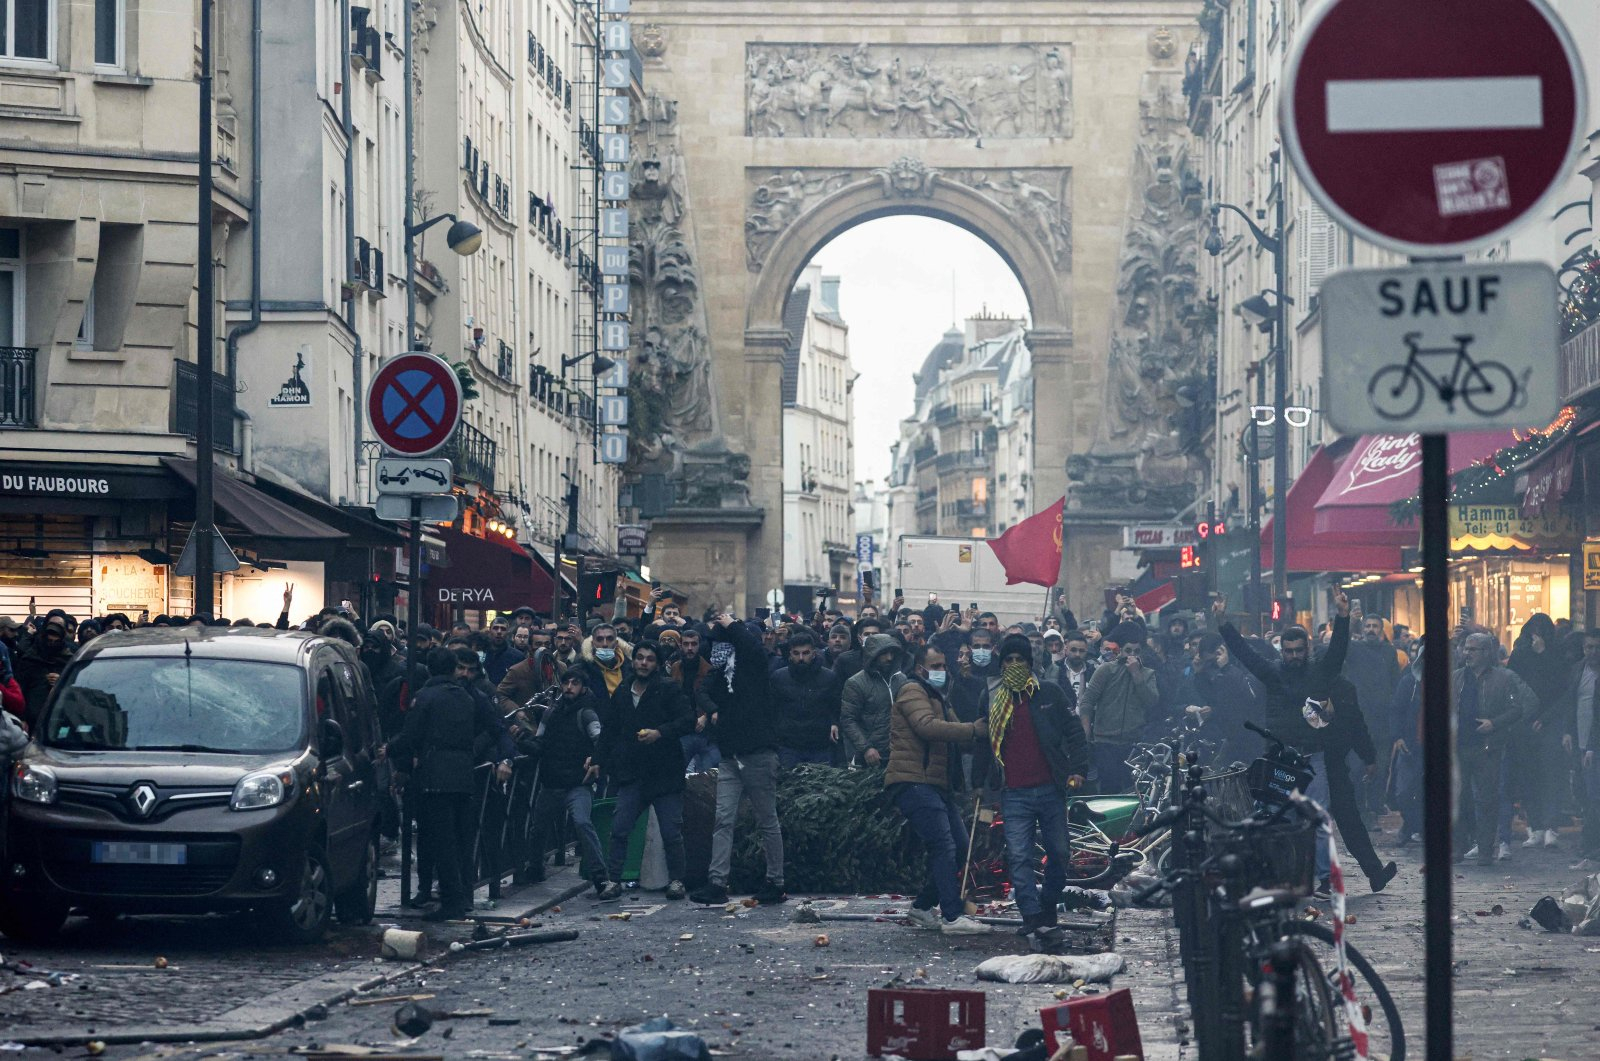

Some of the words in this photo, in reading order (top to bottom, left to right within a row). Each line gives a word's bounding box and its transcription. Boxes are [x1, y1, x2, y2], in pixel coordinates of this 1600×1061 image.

[607, 0, 627, 233] ASSAGE
[606, 254, 625, 267] DU
[1379, 276, 1500, 317] SAUF
[1361, 447, 1416, 472] Lady
[2, 475, 23, 490] DU
[28, 476, 109, 493] FAUBOURG
[1458, 506, 1522, 521] Hamma
[1465, 522, 1487, 534] Tel:
[1496, 522, 1509, 533] 01
[123, 565, 137, 576] LA
[104, 588, 160, 599] OUCHERIE
[439, 588, 494, 602] DERYA
